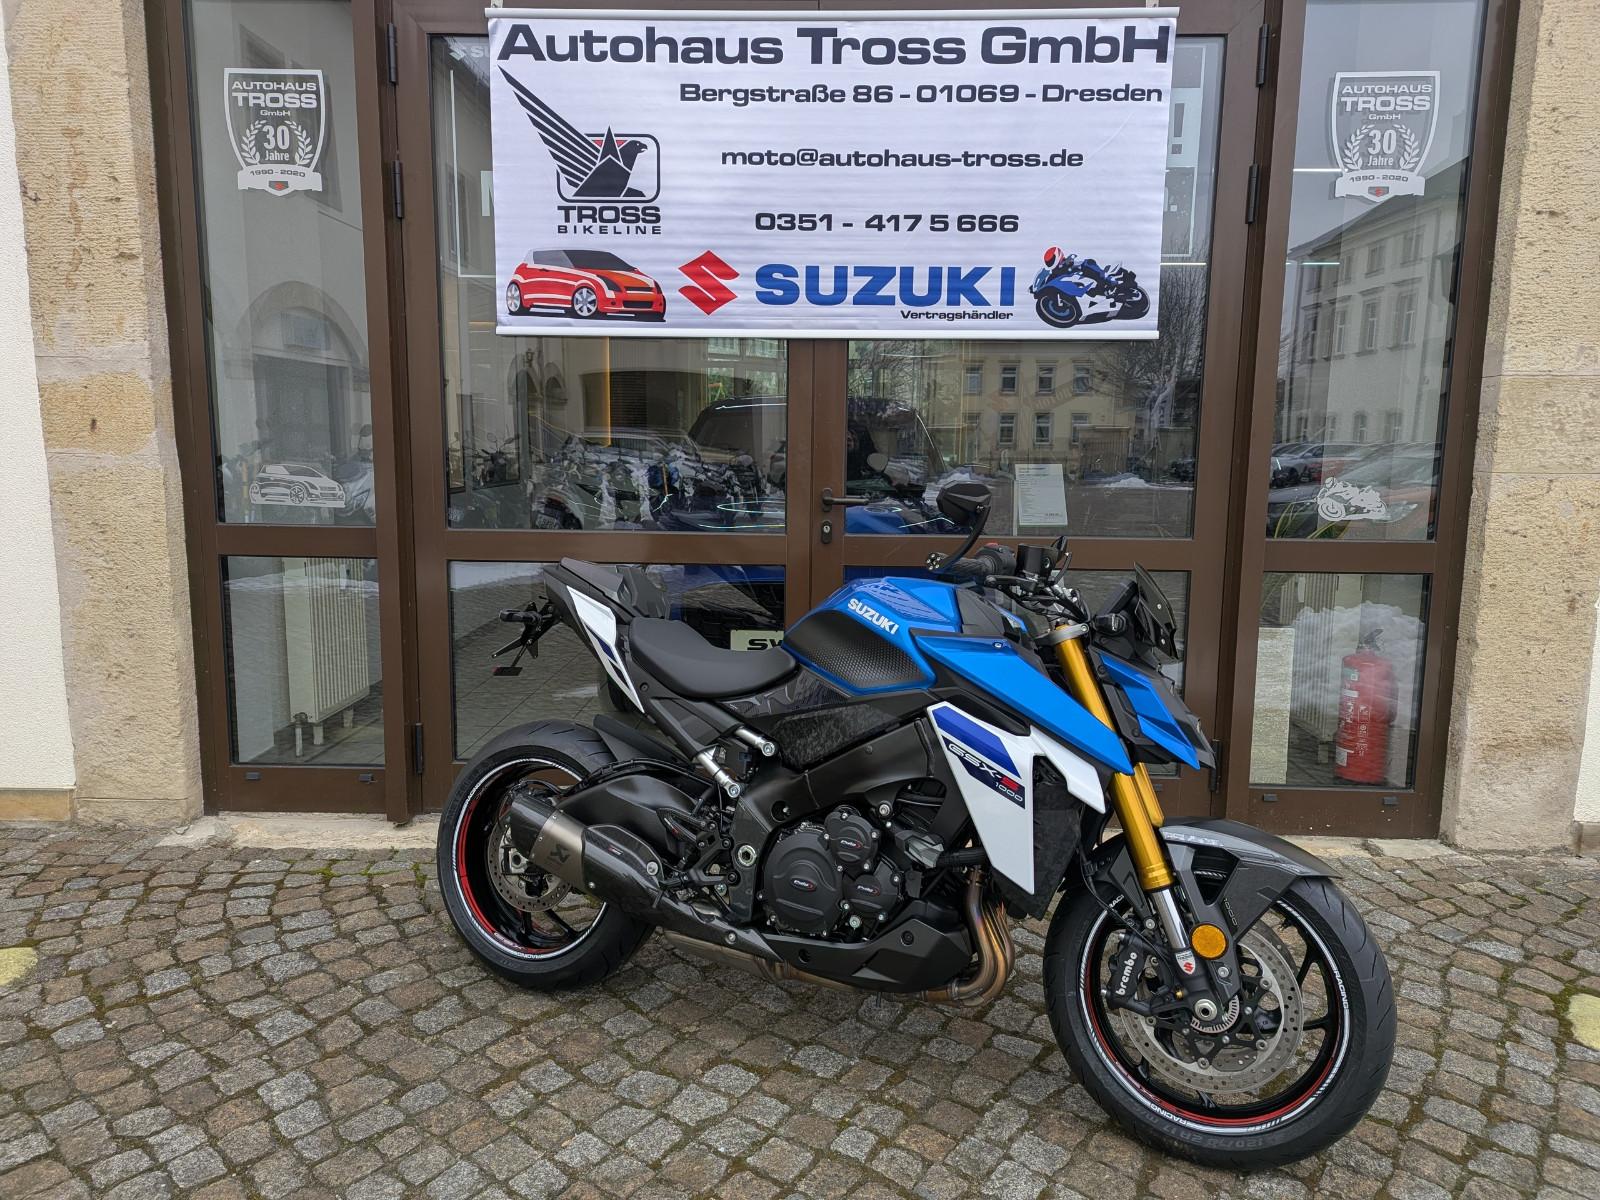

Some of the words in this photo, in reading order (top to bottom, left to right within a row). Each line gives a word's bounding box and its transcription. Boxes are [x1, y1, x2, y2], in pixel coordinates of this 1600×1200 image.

[497, 23, 784, 64] Autohaus
[797, 27, 967, 65] Tross
[981, 25, 1170, 64] GmbH
[231, 81, 317, 91] AUTOHAUS
[680, 83, 846, 107] Bergstraße
[852, 84, 893, 103] 86
[916, 84, 1020, 103] 01069
[1042, 83, 1163, 102] Dresden
[1341, 84, 1433, 94] AUTOHAUS
[231, 92, 318, 108] TROSS
[1340, 95, 1431, 112] TROSS
[262, 125, 290, 150] 30
[1367, 129, 1397, 154] 30
[264, 150, 290, 161] Jahre
[722, 148, 1084, 167] moto@autohaus-tross.de
[1367, 155, 1394, 166] Jahre
[557, 205, 661, 224] TROSS
[755, 212, 833, 231] 0351
[557, 225, 661, 235] BIKELINE
[755, 263, 1017, 307] SUZUKI
[900, 309, 1014, 322] Vertragshändler
[847, 598, 900, 635] SUZUKI
[948, 743, 1020, 792] GSX-S
[995, 782, 1023, 802] 1000
[1115, 952, 1138, 996] brembo
[1334, 970, 1349, 1009] RACING
[1150, 1103, 1189, 1125] RACING
